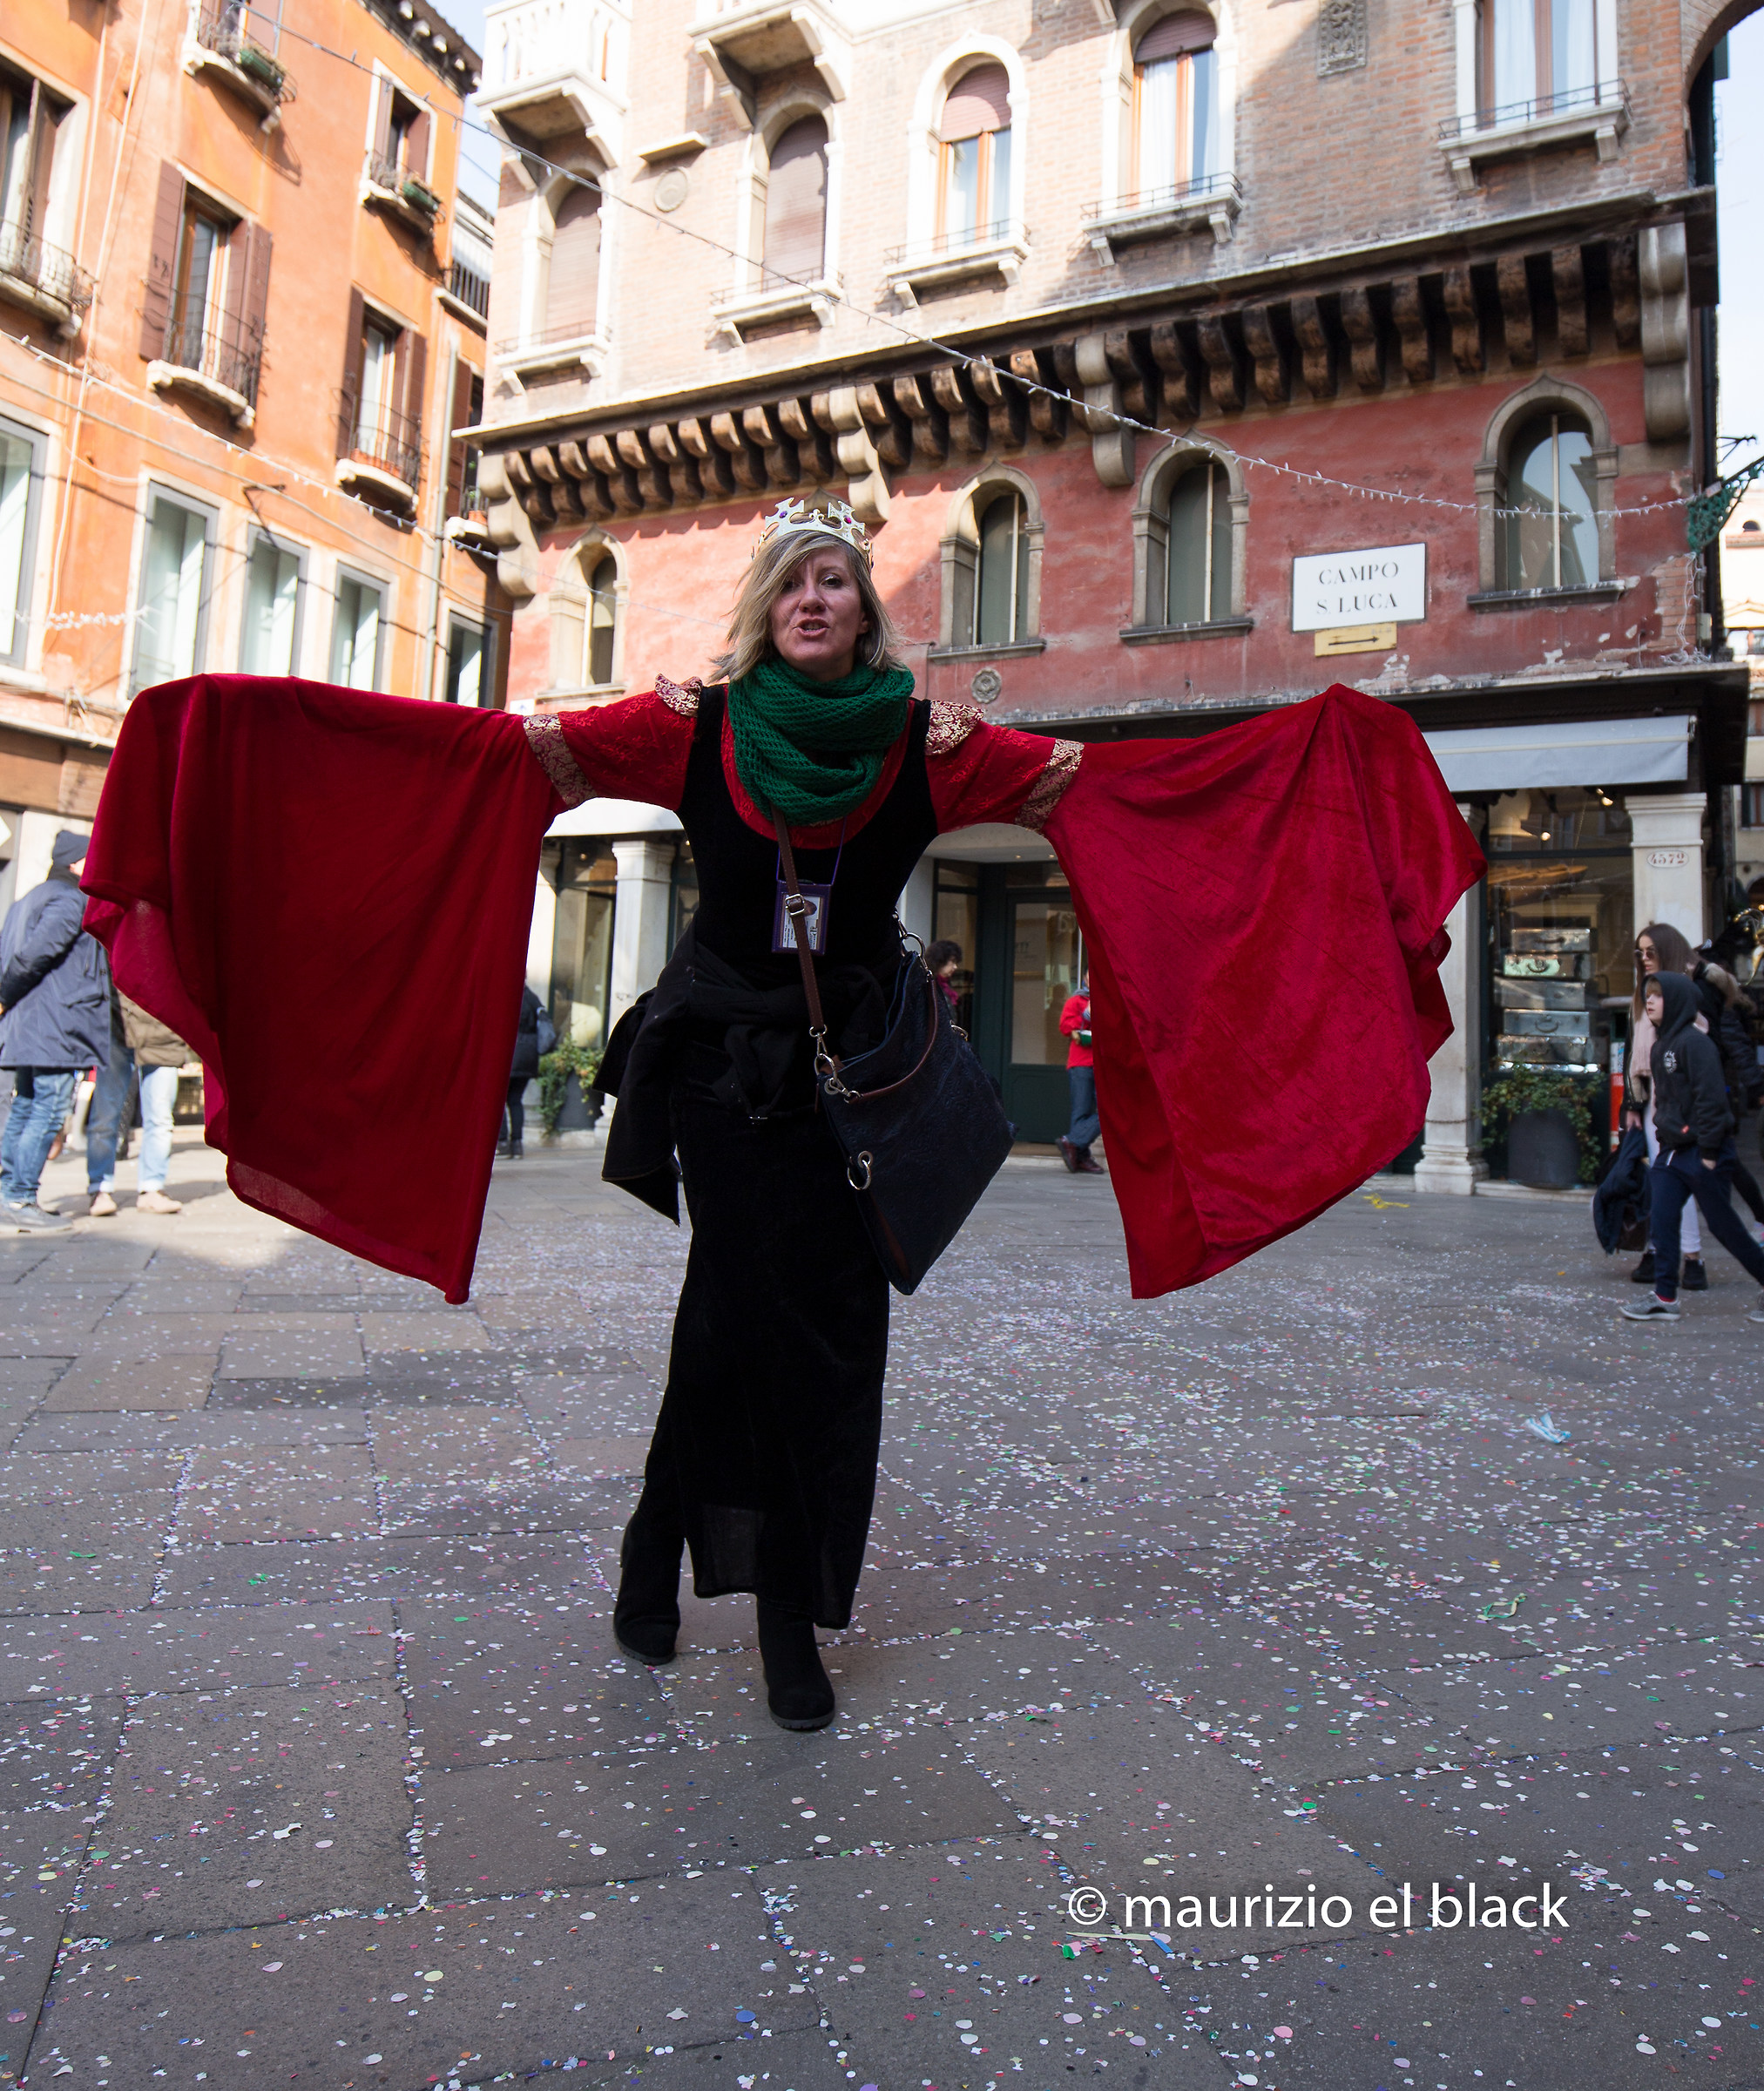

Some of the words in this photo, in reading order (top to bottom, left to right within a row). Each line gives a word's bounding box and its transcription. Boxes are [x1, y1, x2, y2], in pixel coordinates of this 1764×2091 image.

[1318, 561, 1399, 585] CAMPO
[1316, 599, 1331, 614] S.
[1338, 592, 1397, 613] LUCA
[1650, 852, 1686, 865] 4572
